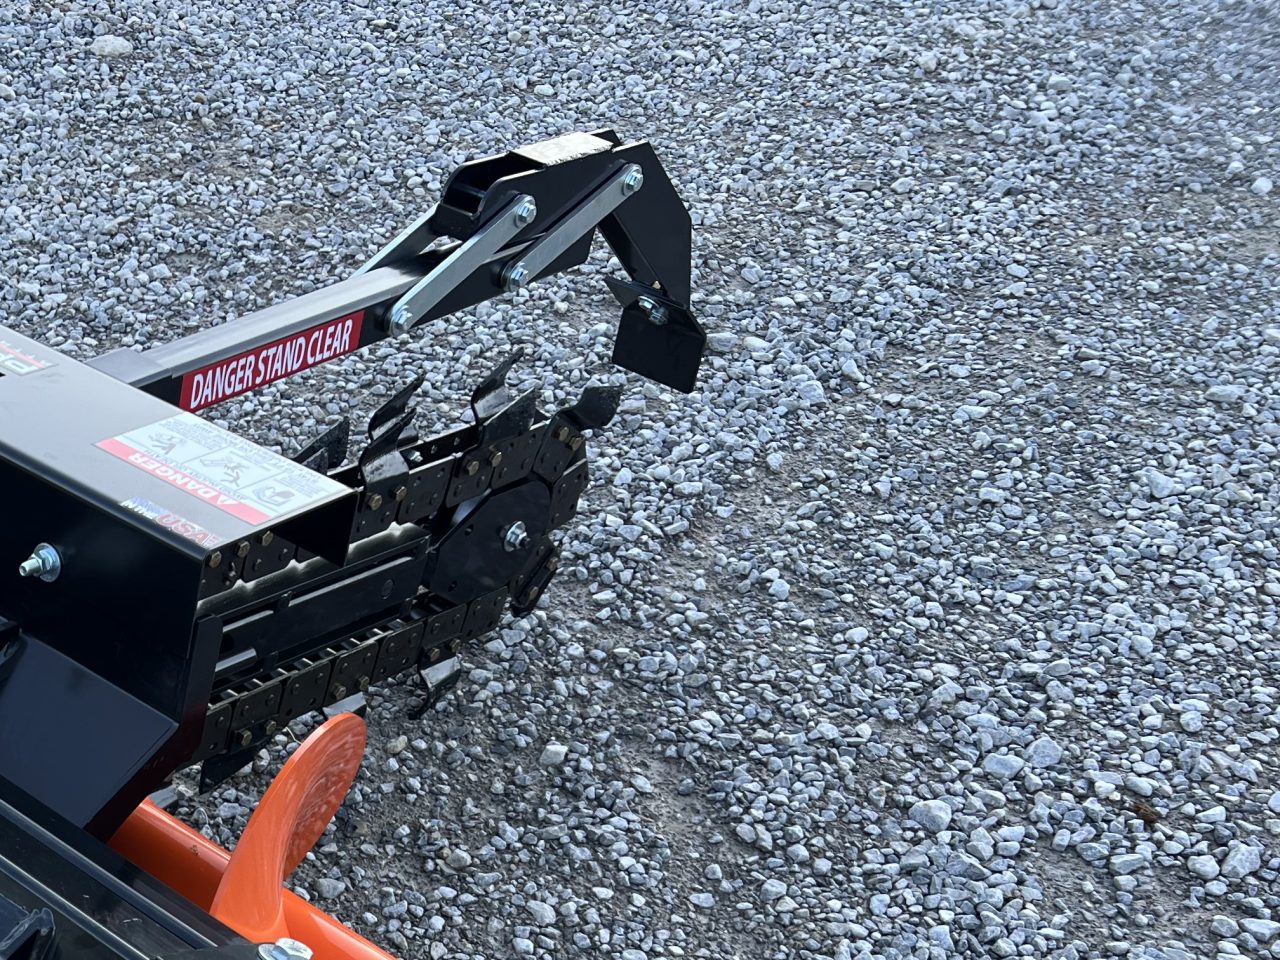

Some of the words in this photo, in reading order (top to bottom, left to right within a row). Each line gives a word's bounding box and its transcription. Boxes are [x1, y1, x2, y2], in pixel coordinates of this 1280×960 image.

[190, 354, 255, 409] DANGER
[255, 336, 306, 385] STAND
[307, 319, 353, 365] CLEAR
[128, 452, 218, 499] DANGER
[156, 512, 209, 544] USA
